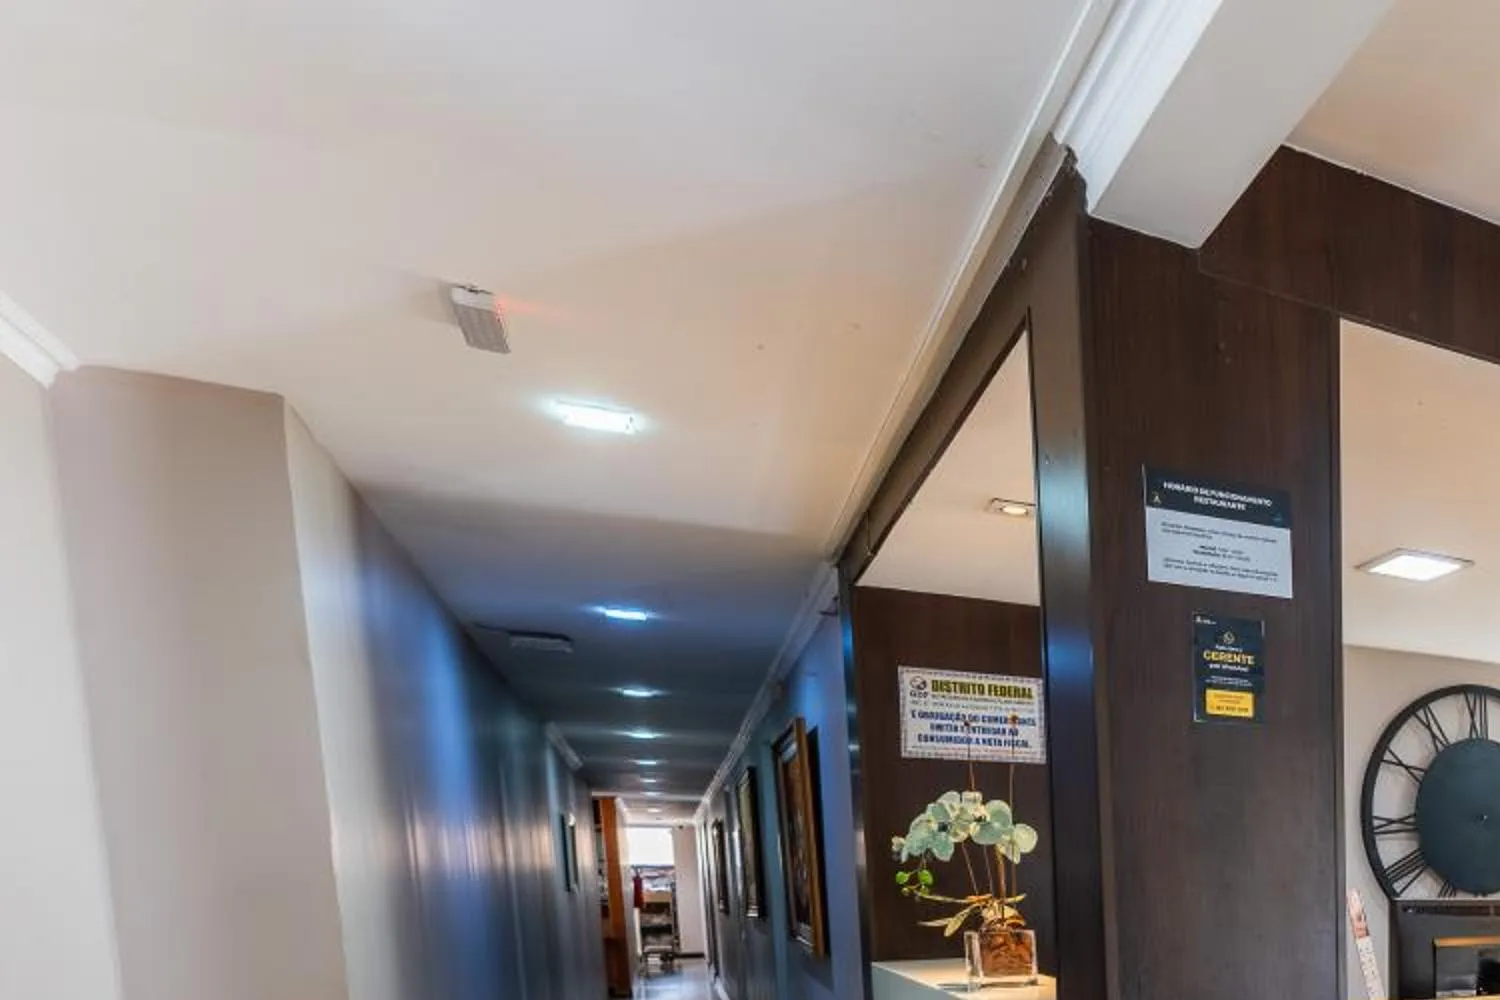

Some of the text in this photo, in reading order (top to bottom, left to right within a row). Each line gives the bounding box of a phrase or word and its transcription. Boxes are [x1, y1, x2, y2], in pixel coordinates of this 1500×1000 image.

[1203, 650, 1254, 665] GERENTE
[931, 679, 985, 696] DISTRITO
[987, 683, 1033, 699] FEDERAL
